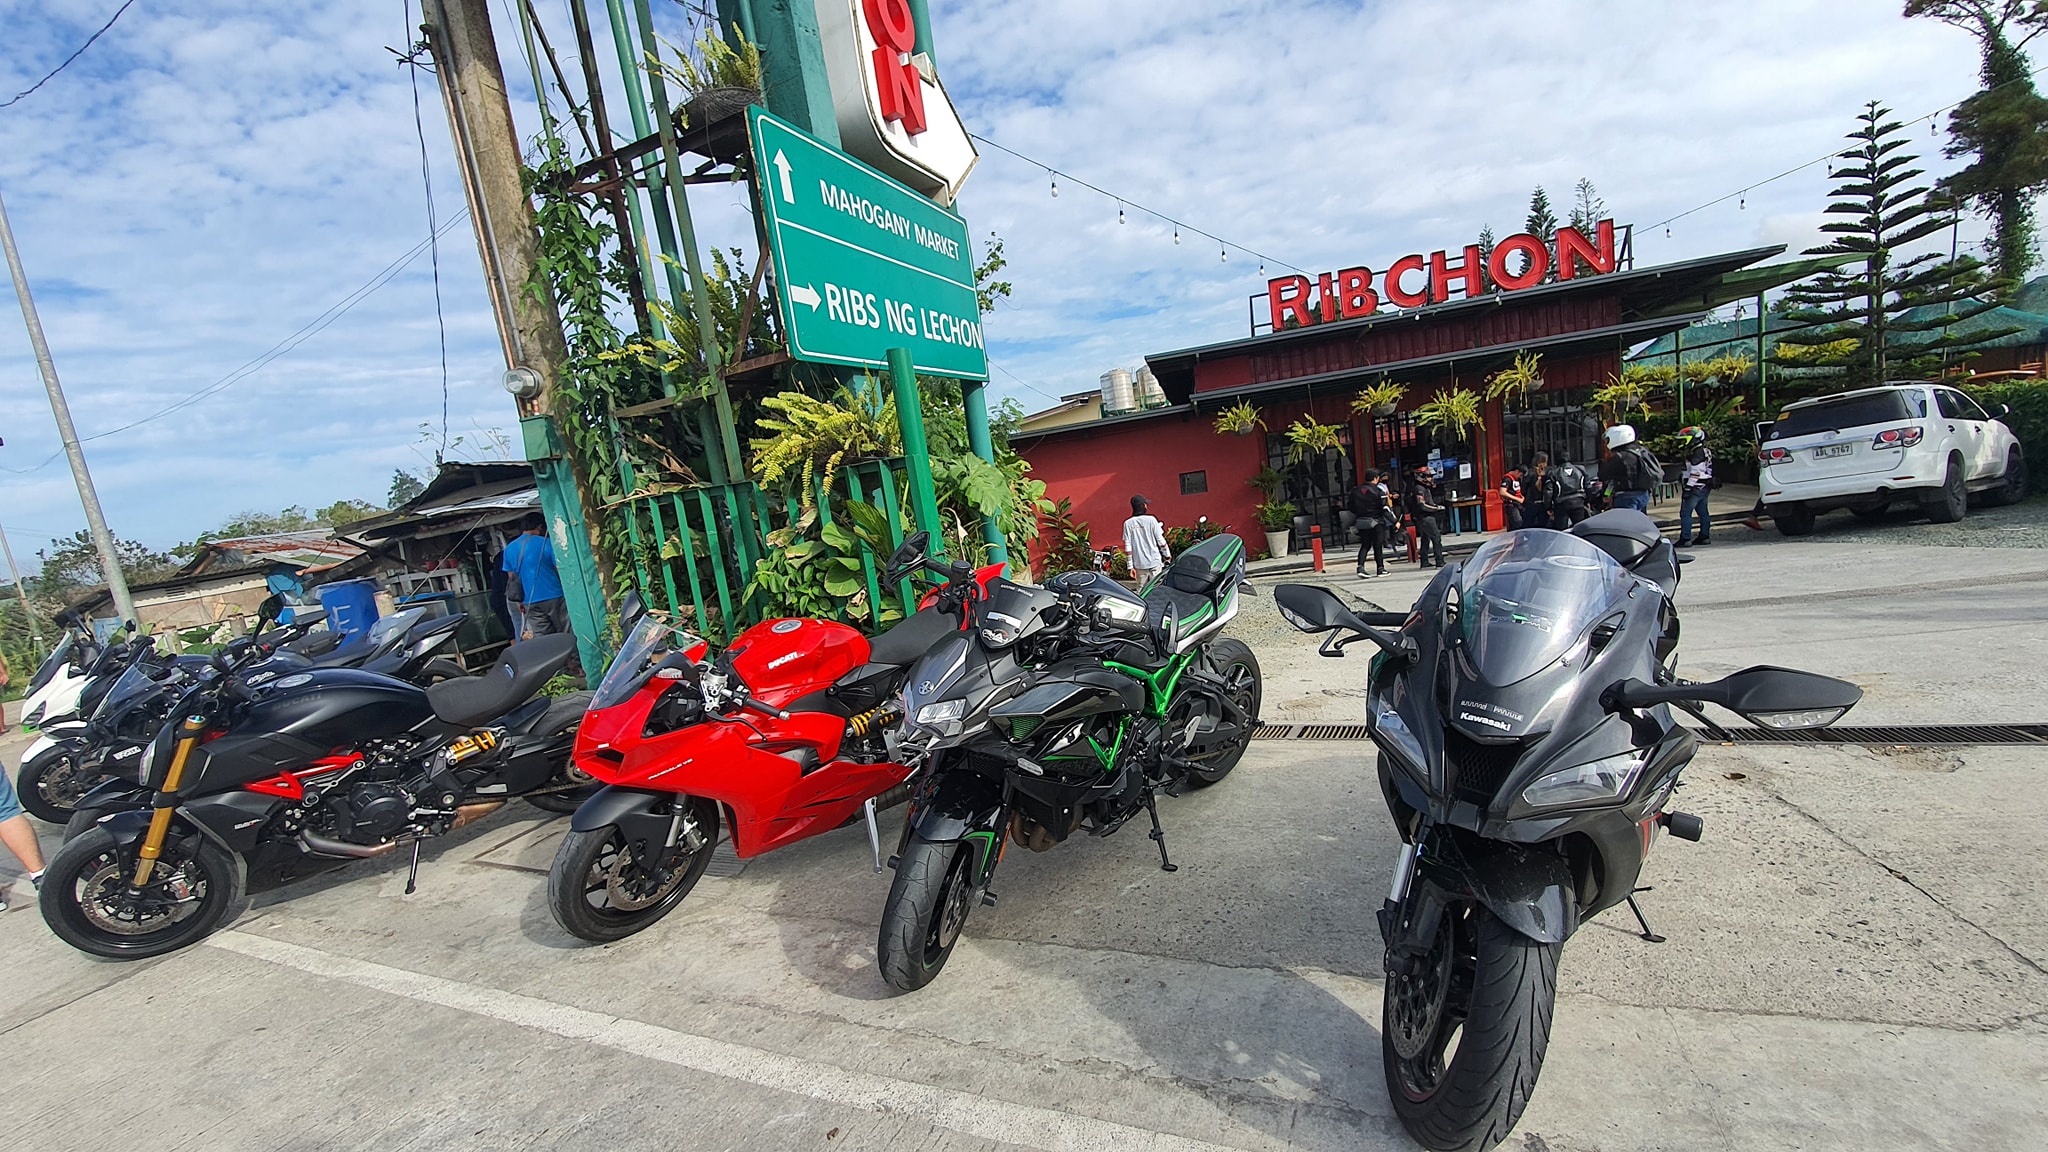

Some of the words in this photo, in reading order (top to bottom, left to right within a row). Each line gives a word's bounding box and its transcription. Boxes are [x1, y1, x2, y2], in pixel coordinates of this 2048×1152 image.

[819, 179, 912, 240] MAHOGANY
[914, 218, 960, 261] MARKET
[1267, 218, 1615, 332] RIBCHON
[824, 282, 881, 330] RIBS
[884, 298, 917, 337] NG
[920, 308, 983, 350] LECHON
[767, 651, 798, 670] DUCATI
[1460, 711, 1512, 732] Kawasaki
